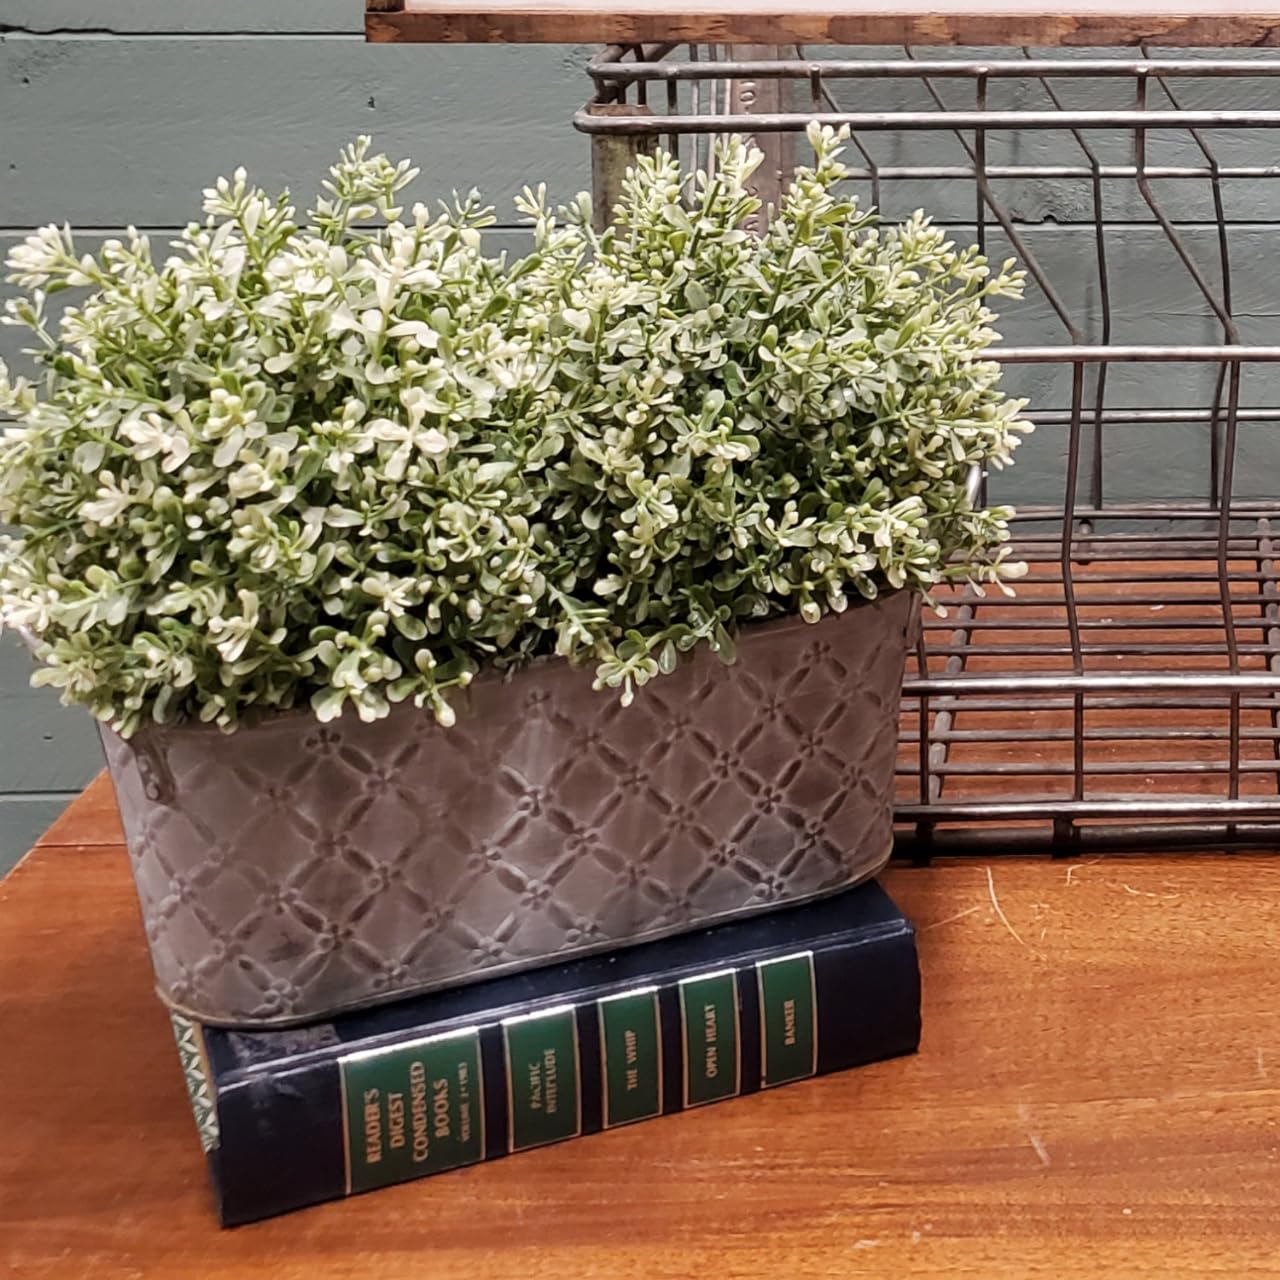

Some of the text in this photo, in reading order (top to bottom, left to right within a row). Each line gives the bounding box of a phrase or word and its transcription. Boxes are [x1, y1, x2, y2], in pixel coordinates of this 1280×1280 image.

[703, 1003, 718, 1078] OPEN HEART
[783, 999, 796, 1046] BANKER
[528, 1061, 543, 1109] PACIFIC
[624, 1029, 638, 1091] THE WHIP
[364, 1088, 382, 1163] READER'S
[388, 1092, 406, 1149] DIGEST
[410, 1061, 429, 1162] CONDENSED
[433, 1078, 450, 1138] BOOKS
